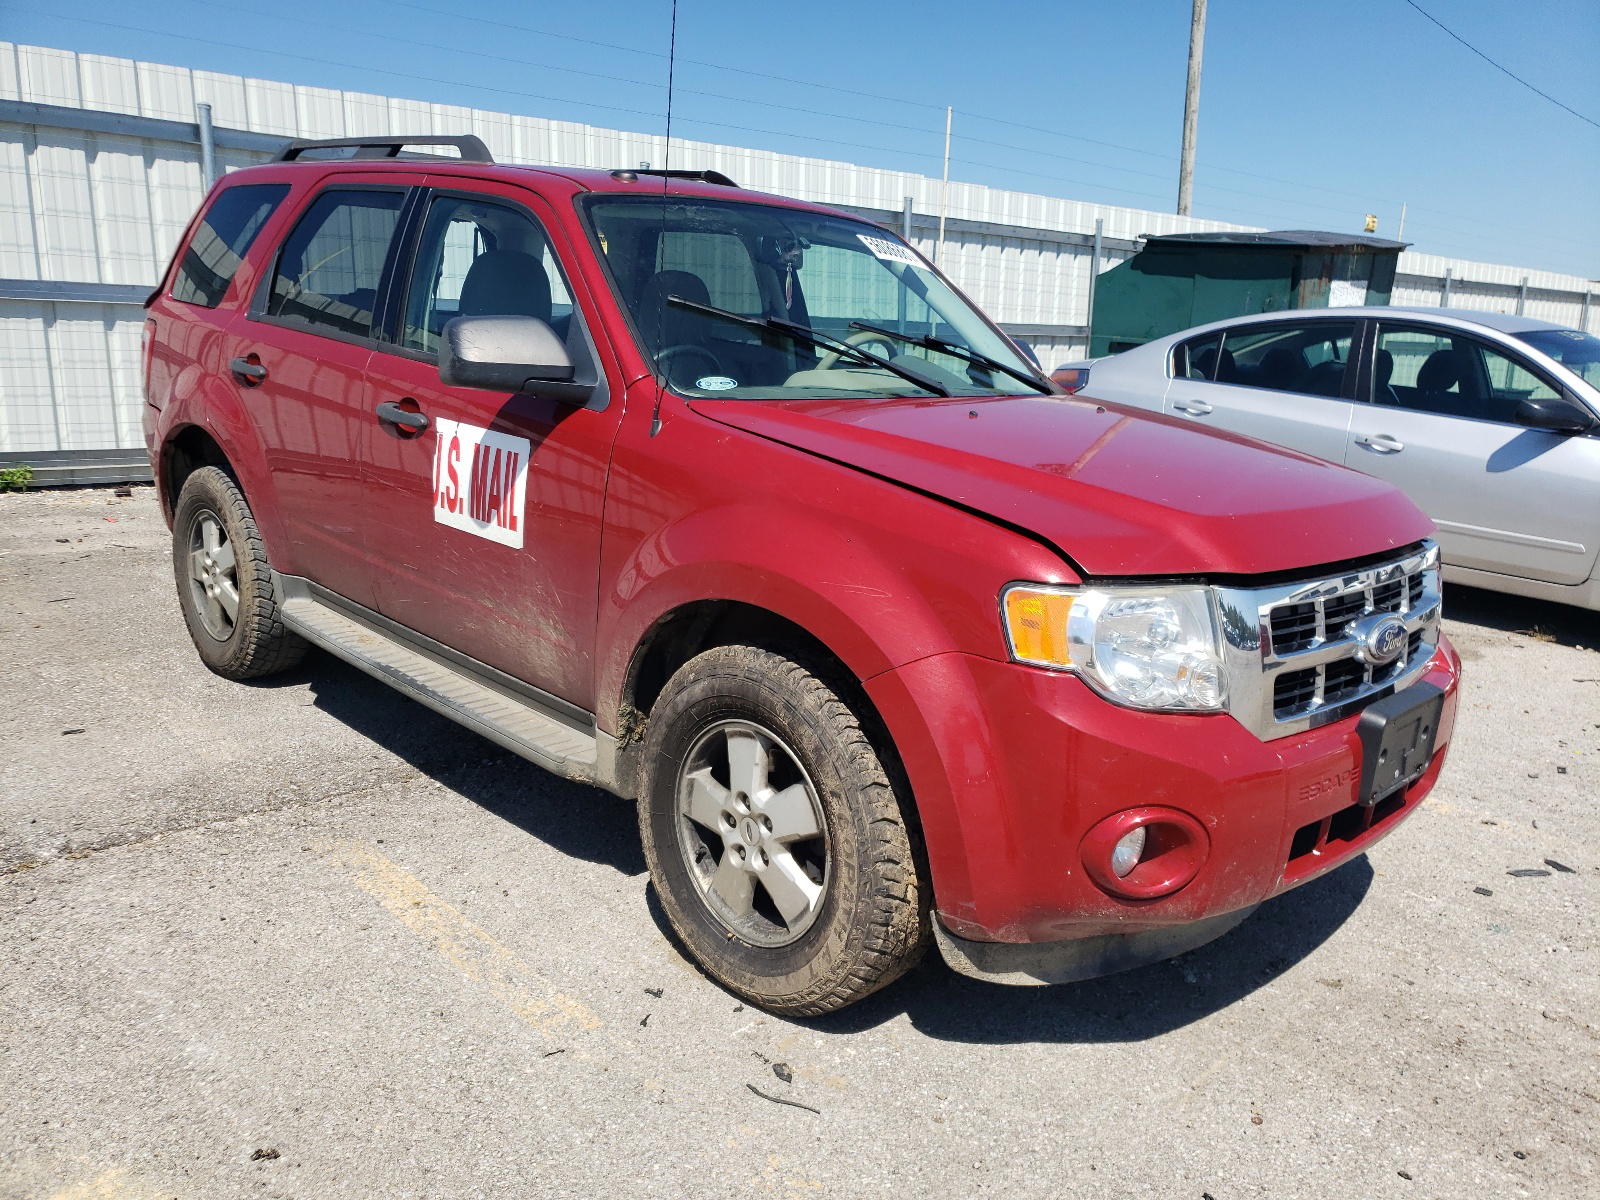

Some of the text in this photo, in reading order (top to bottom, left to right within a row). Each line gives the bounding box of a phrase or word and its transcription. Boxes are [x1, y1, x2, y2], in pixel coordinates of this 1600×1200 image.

[470, 443, 519, 532] MAIL
[1383, 626, 1403, 652] Ford
[1299, 767, 1360, 801] ESCAPE
